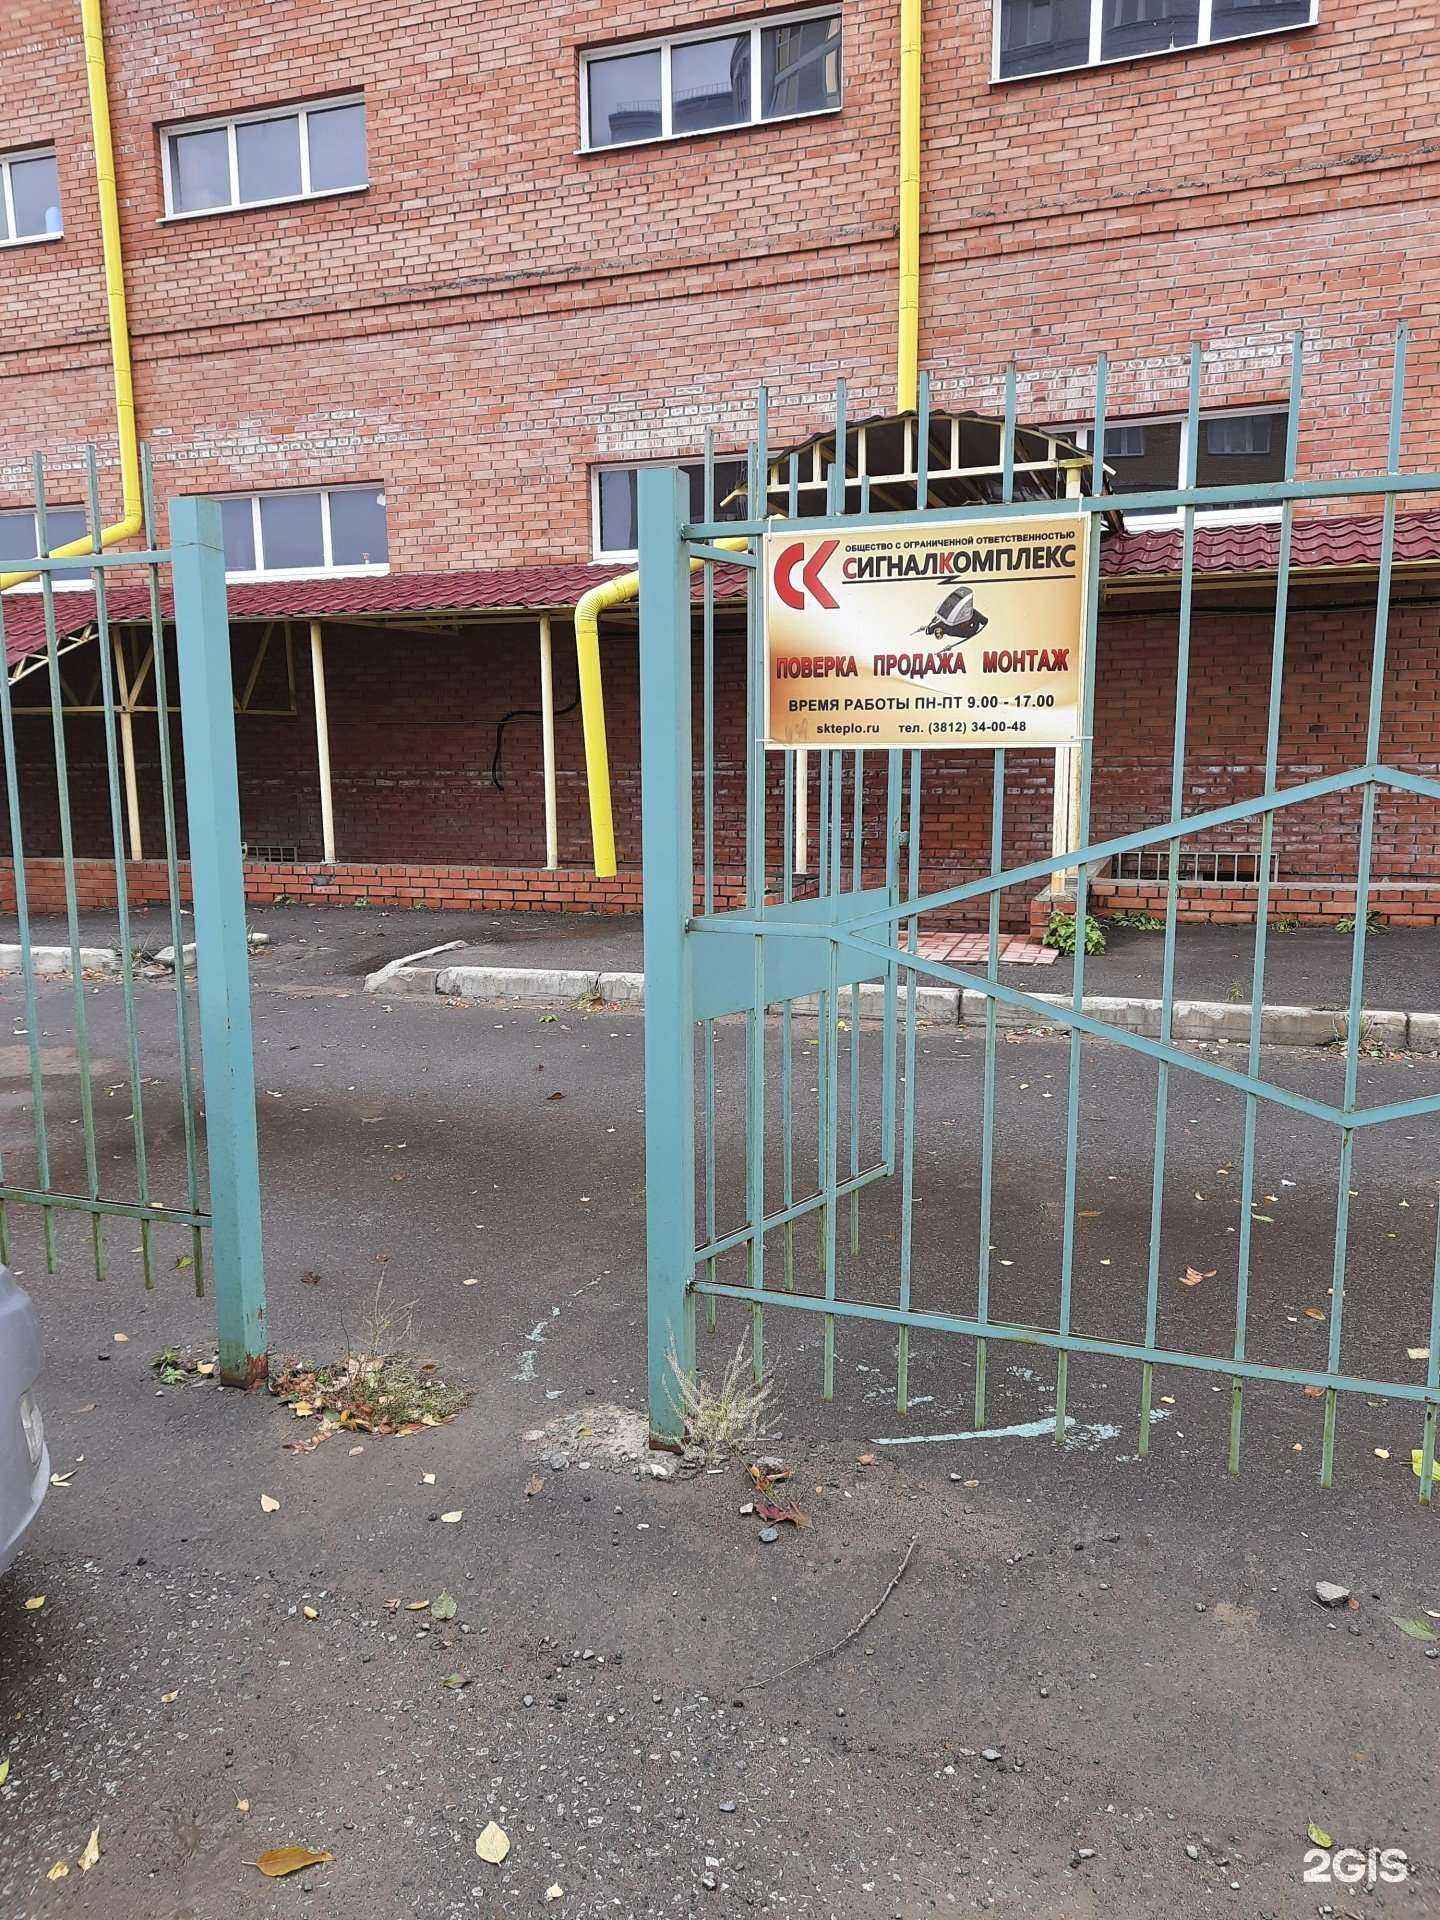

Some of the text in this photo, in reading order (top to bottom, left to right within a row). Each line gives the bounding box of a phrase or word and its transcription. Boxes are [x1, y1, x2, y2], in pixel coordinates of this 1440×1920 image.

[845, 542, 894, 552] ОБЩЕСТВО
[903, 536, 974, 549] ОГРАНИЧЕННОЙ
[976, 530, 1075, 545] ОТВЕТСТВЕННОСТЬЮ
[842, 544, 1077, 579] СИГНАЛКОМПЛЕКС
[776, 648, 1070, 679] ПОВЕРКА ПРОДАЖА МОНТАЖ
[788, 698, 840, 712] ВРЕМЯ
[844, 697, 910, 711] РАБОТЫ
[914, 696, 962, 710] ПН-ПТ
[967, 695, 999, 709] 9.00
[1014, 694, 1055, 708] 17.00
[816, 722, 880, 735] skteplo.ru
[898, 720, 1027, 735] тел. (3812) 34-00-48
